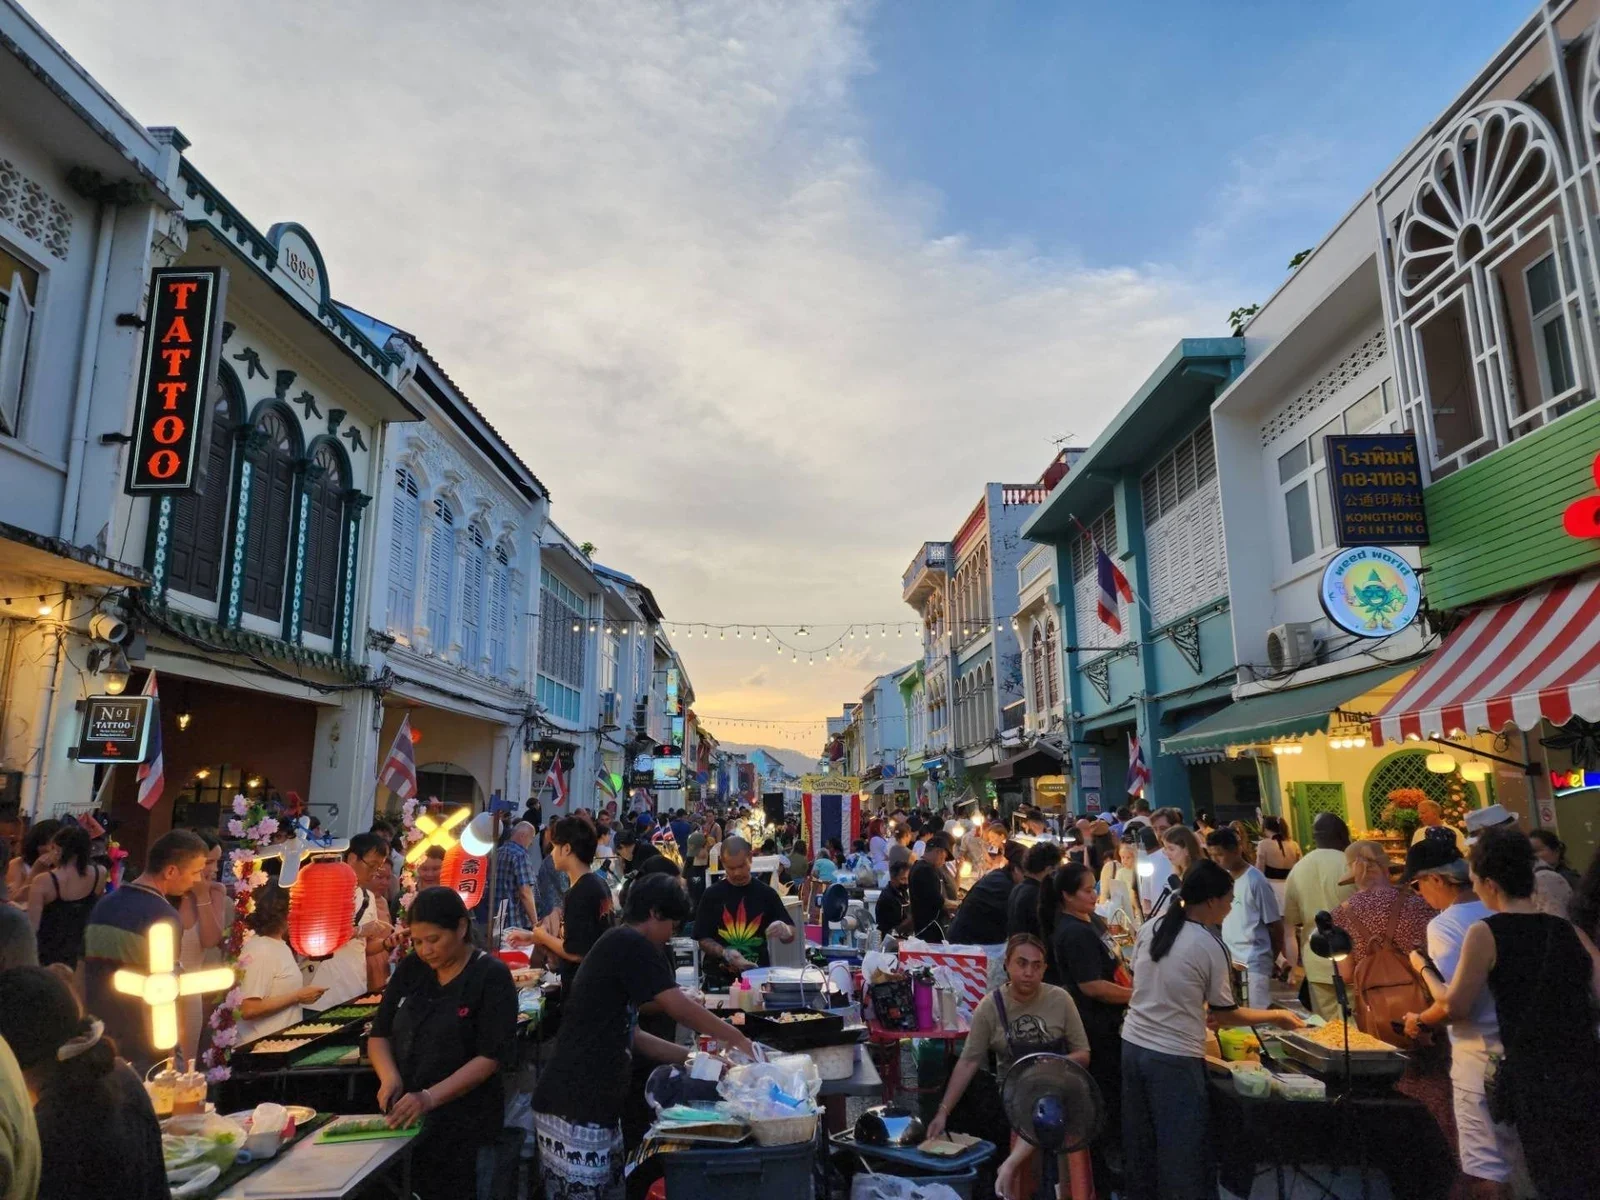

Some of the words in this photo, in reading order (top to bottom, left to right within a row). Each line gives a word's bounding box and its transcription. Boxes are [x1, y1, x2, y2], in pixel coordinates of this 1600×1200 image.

[285, 247, 315, 286] 1889
[147, 282, 198, 479] TATTOO
[1337, 444, 1415, 466] โรงพิมพ์
[1341, 471, 1417, 487] กองทอง
[1346, 512, 1423, 522] KONGTHONG
[1347, 524, 1425, 534] PRINTING
[1335, 550, 1367, 576] weed
[1372, 551, 1411, 577] world
